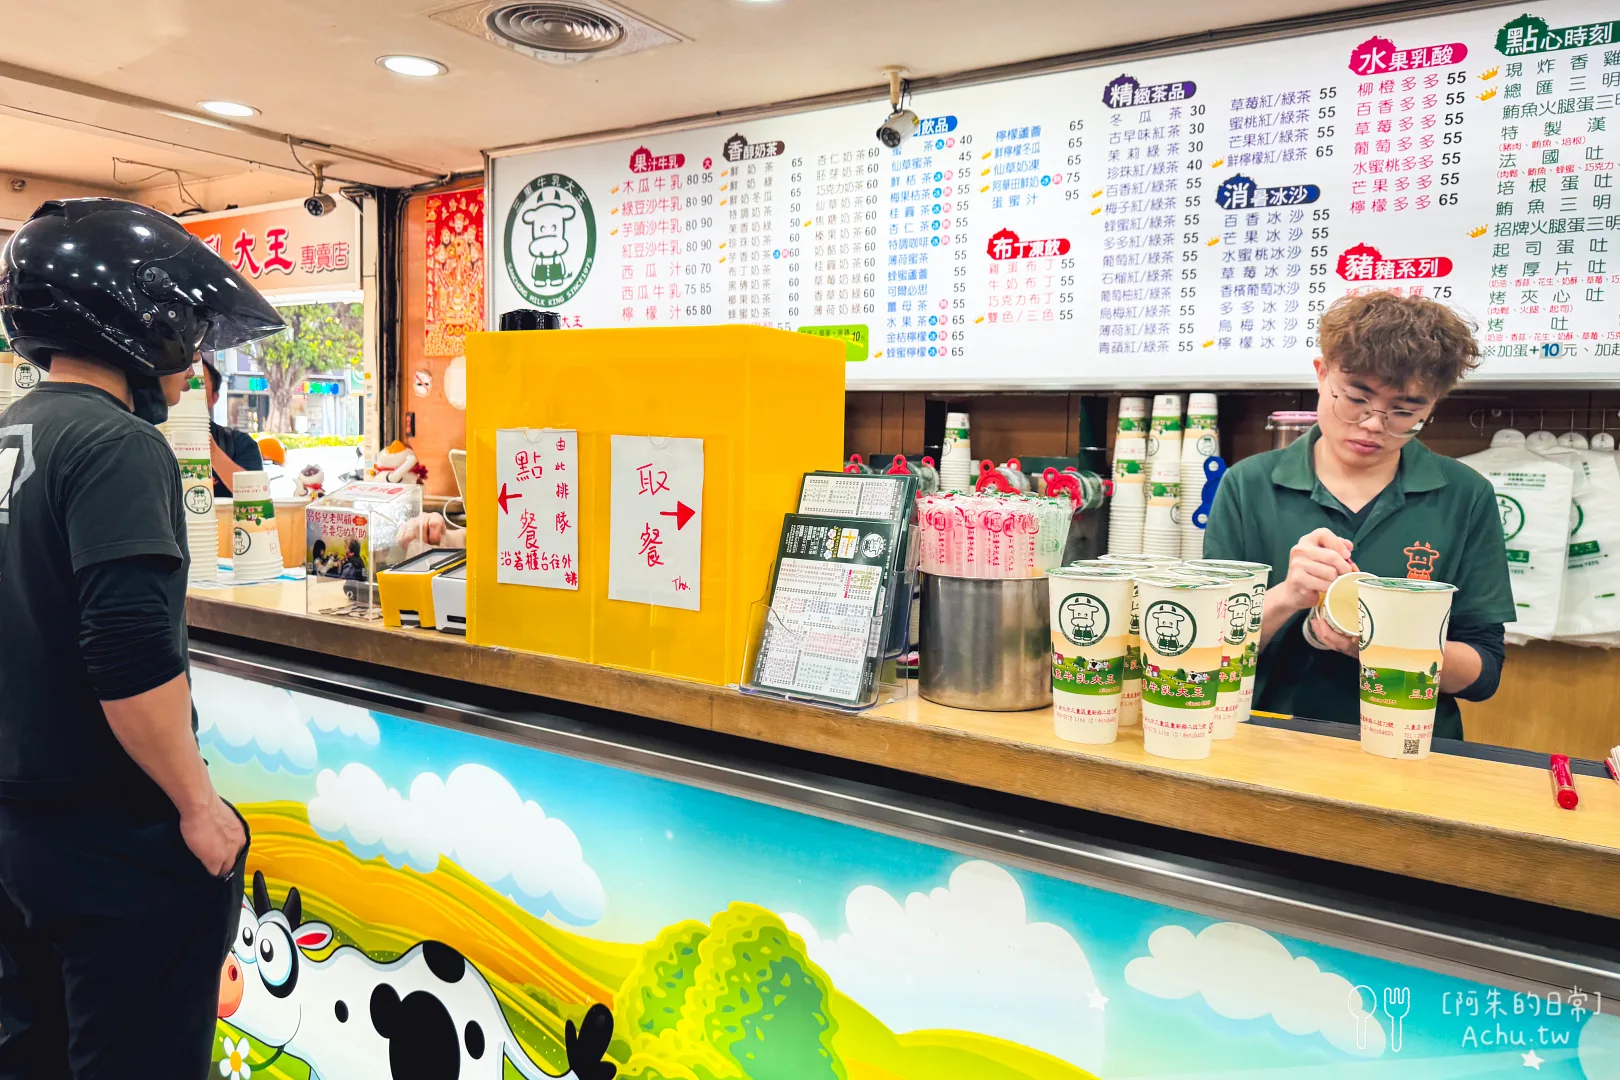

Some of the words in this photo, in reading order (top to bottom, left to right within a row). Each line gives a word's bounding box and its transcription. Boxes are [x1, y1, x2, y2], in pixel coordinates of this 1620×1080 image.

[1505, 22, 1613, 55] 點心時刻
[1357, 45, 1454, 74] 水果乳酸
[1357, 73, 1439, 97] 柳橙多多
[1446, 71, 1467, 85] 55
[1109, 82, 1185, 108] 精緻茶品
[1230, 89, 1311, 112] 草莓紅/綠茶
[1319, 86, 1337, 100] 55
[1357, 93, 1438, 117] 百香多多
[1445, 91, 1465, 105] 55
[1069, 119, 1083, 131] 65
[1110, 106, 1182, 127] 冬瓜茶
[1190, 104, 1206, 116] 30
[1229, 108, 1310, 131] 蜜桃紅/綠茶
[1318, 105, 1336, 119] 55
[1355, 114, 1437, 136] 草莓多多
[1444, 112, 1464, 126] 55
[1068, 137, 1082, 148] 65
[1109, 125, 1181, 144] 古早味紅茶
[1189, 122, 1204, 135] 30
[1228, 128, 1309, 149] 芒果紅/綠茶
[1317, 125, 1335, 138] 55
[728, 140, 778, 161] 香醇奶茶
[1108, 143, 1180, 162] 茉莉綠茶
[1188, 140, 1204, 153] 30
[1316, 145, 1333, 158] 65
[1354, 134, 1435, 156] 葡萄多多
[1443, 131, 1463, 145] 55
[633, 153, 679, 172] 果汁牛乳
[1067, 154, 1081, 166] 65
[1352, 154, 1434, 176] 水蜜桃多多
[1441, 152, 1461, 166] 55
[1499, 145, 1604, 169] 法國吐
[1066, 172, 1080, 183] 75
[1107, 161, 1179, 180] 珍珠紅/綠茶
[1186, 159, 1203, 171] 40
[622, 174, 683, 195] 木瓜牛乳
[686, 173, 699, 185] 80
[701, 172, 713, 184] 95
[1106, 179, 1178, 198] 百香紅/綠茶
[1186, 177, 1202, 189] 55
[1351, 174, 1432, 195] 芒果多多
[1440, 172, 1460, 186] 55
[1497, 172, 1613, 196] 培根蛋吐
[622, 196, 683, 216] 綠豆沙牛乳
[685, 197, 697, 208] 80
[701, 194, 713, 206] 90
[1065, 189, 1079, 201] 95
[1105, 197, 1177, 215] 梅子紅/綠茶
[1185, 195, 1201, 208] 55
[1223, 182, 1308, 208] 消暑冰沙
[1349, 194, 1431, 215] 檸檬多多
[1439, 192, 1458, 206] 65
[1495, 194, 1611, 217] 鮪魚三明
[622, 218, 682, 238] 芋頭沙牛乳
[685, 219, 697, 231] 80
[700, 217, 712, 228] 90
[1104, 215, 1176, 232] 蜂蜜紅/綠茶
[1184, 214, 1200, 226] 55
[1224, 209, 1304, 227] 百香冰沙
[1313, 208, 1330, 221] 55
[1104, 233, 1175, 250] 多多紅/綠茶
[1183, 232, 1199, 244] 55
[1223, 227, 1303, 245] 芒果冰沙
[1312, 227, 1329, 240] 55
[299, 241, 350, 273] 專賣店
[622, 239, 682, 258] 紅豆沙牛乳
[686, 241, 698, 252] 80
[700, 239, 712, 251] 90
[993, 236, 1061, 259] 布丁凍飲
[1222, 245, 1302, 263] 水蜜桃冰沙
[1311, 245, 1328, 257] 55
[1492, 237, 1608, 258] 起司蛋吐
[1060, 258, 1075, 269] 55
[1102, 251, 1175, 267] 葡萄紅/綠茶
[1182, 250, 1198, 262] 55
[1345, 253, 1439, 280] 豬豬系列
[1491, 258, 1607, 278] 烤厚片吐
[621, 261, 682, 280] 西瓜汁
[685, 264, 697, 275] 60
[700, 263, 712, 274] 70
[1101, 269, 1174, 284] 石榴紅/綠茶
[1181, 268, 1197, 280] 55
[1221, 263, 1301, 280] 草莓冰沙
[1310, 263, 1327, 275] 55
[621, 283, 681, 300] 西瓜牛乳
[684, 284, 697, 295] 75
[700, 282, 712, 293] 85
[988, 275, 1055, 291] 牛奶布丁
[1060, 275, 1074, 286] 55
[1180, 287, 1196, 298] 55
[1309, 281, 1326, 293] 55
[547, 295, 565, 307] KING
[988, 292, 1054, 307] 巧克力布丁
[1059, 292, 1073, 303] 55
[1489, 287, 1604, 306] 烤夾心吐
[686, 305, 698, 316] 65
[700, 304, 712, 315] 80
[1059, 309, 1073, 320] 55
[1179, 305, 1195, 316] 55
[1220, 299, 1299, 315] 多多冰沙
[1178, 322, 1194, 334] 55
[1178, 341, 1193, 352] 55
[554, 437, 572, 535] 由此排隊
[514, 450, 544, 550] 點餐
[636, 462, 671, 568] 取餐
